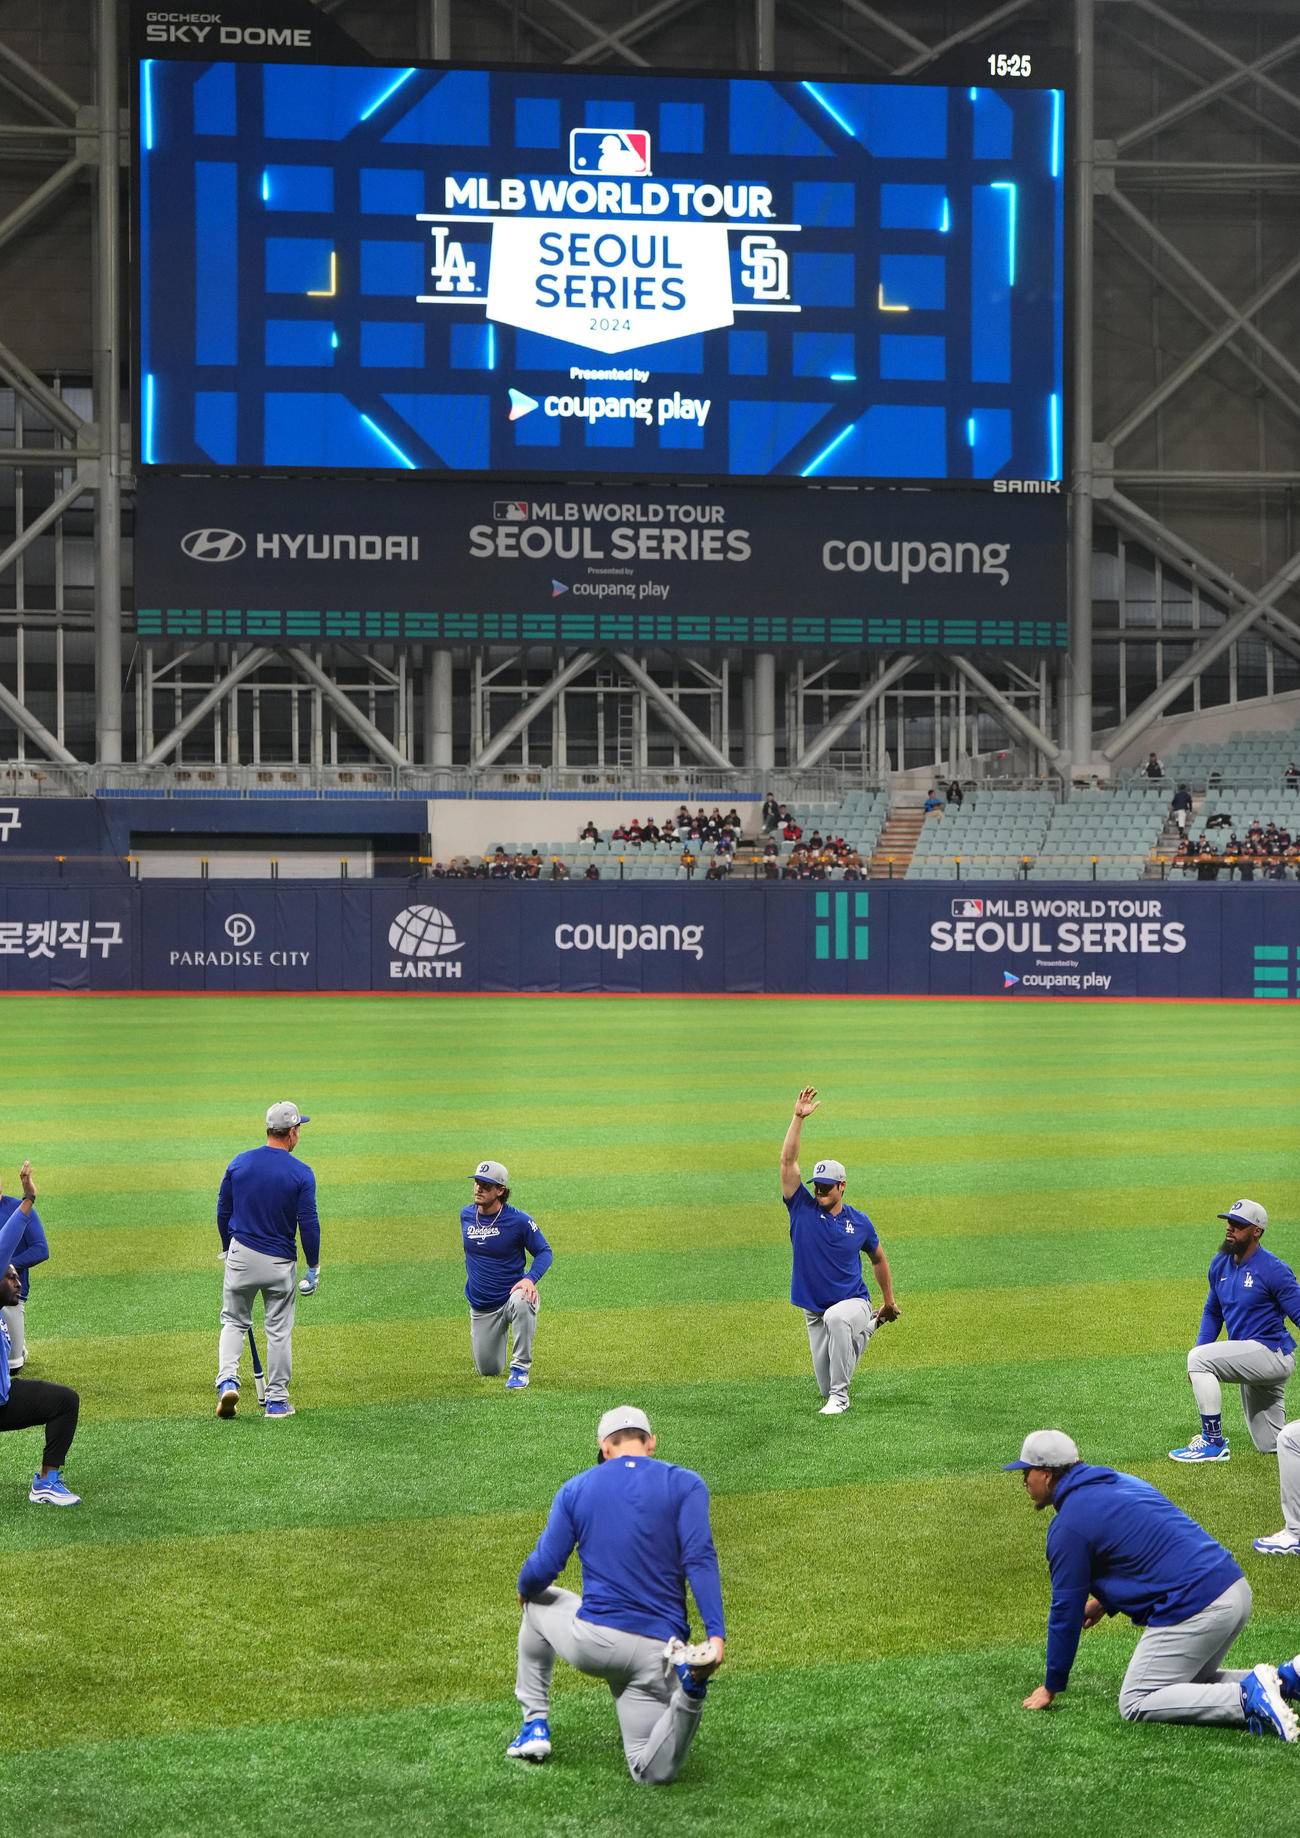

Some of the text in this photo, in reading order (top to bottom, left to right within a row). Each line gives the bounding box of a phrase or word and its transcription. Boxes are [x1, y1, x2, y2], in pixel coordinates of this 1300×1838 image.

[146, 12, 222, 23] GOCHEOK
[146, 25, 312, 46] SKY DOME
[987, 53, 1032, 78] 15:25
[445, 177, 774, 217] MLB WORLD TOUR
[431, 226, 476, 292] LA
[539, 231, 683, 269] SEOUL
[740, 235, 789, 300] SD
[535, 273, 686, 311] SERIES
[589, 317, 631, 332] 2024
[569, 366, 650, 384] Presented by
[544, 391, 711, 427] coupang play
[993, 479, 1061, 494] SAMIK
[531, 502, 725, 523] MLB WORLD TOUR
[256, 533, 419, 561] HYUNDAI
[469, 525, 752, 562] SEOUL SERIES
[587, 566, 634, 577] Presented by
[822, 540, 1011, 586] coupang
[572, 580, 670, 600] coupang play
[986, 900, 1162, 918] MLB WORLD TOUR
[0, 919, 123, 959] 로켓직구
[554, 923, 705, 961] coupang
[930, 921, 1187, 954] SEOUL SERIES
[170, 951, 310, 966] PARADISE CITY
[1036, 959, 1079, 969] Presented by
[389, 961, 462, 978] EARTH
[1022, 971, 1112, 990] coupang play
[466, 1225, 500, 1239] Dodgers
[845, 1219, 855, 1234] LA
[1243, 1271, 1254, 1287] LA
